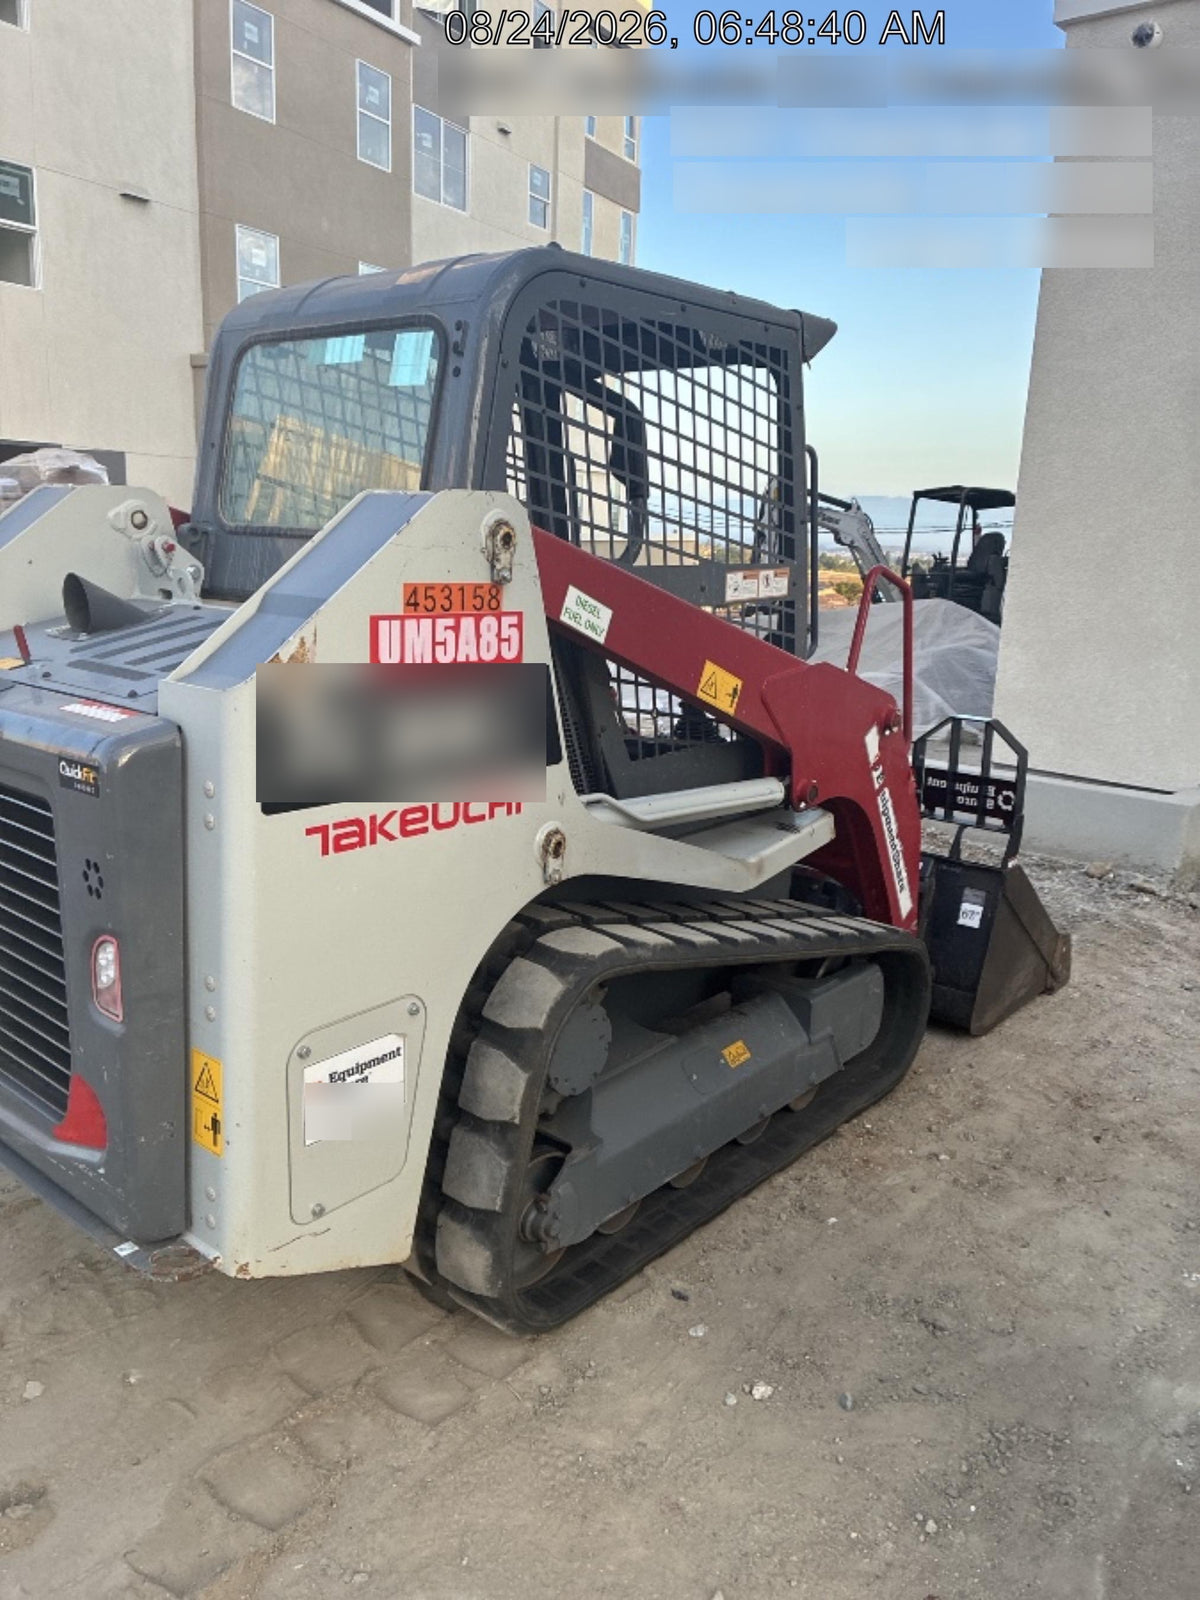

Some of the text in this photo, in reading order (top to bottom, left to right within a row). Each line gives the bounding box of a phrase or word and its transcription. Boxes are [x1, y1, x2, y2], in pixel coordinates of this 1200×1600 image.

[405, 585, 501, 613] 453158
[378, 615, 520, 664] UM5A85
[328, 1046, 402, 1083] Equipment
